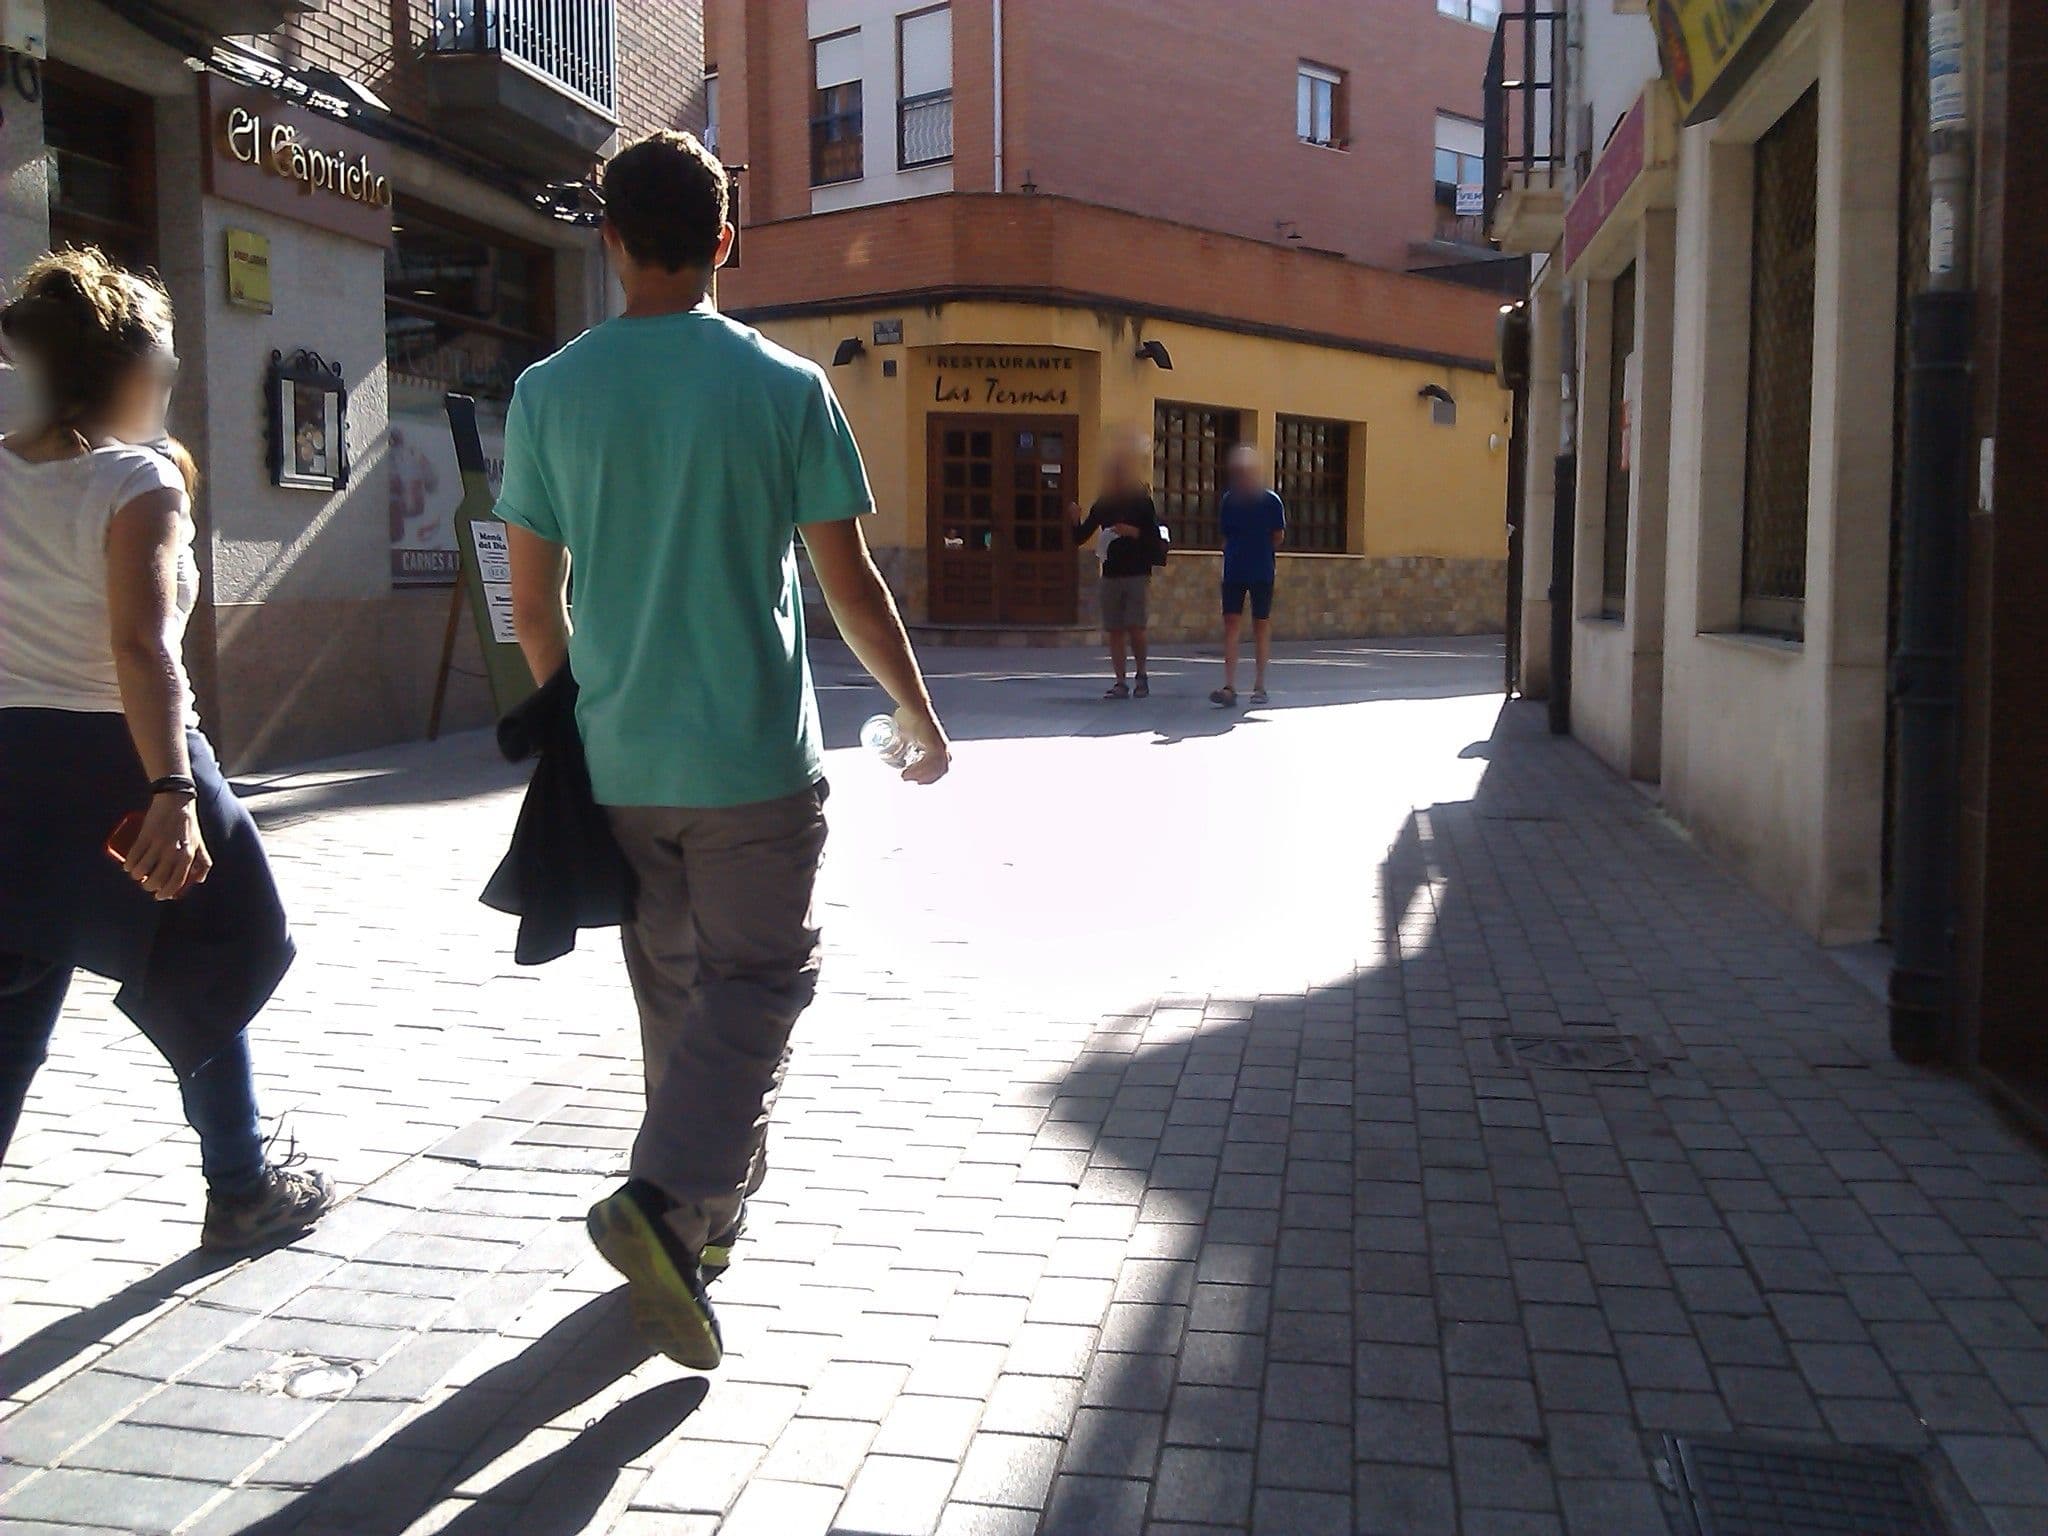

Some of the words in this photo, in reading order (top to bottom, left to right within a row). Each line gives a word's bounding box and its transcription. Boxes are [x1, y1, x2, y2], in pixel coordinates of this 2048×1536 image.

[227, 106, 261, 165] El
[270, 123, 393, 208] Capricho
[937, 355, 1072, 369] RESTAURANTE
[935, 374, 970, 402] Las
[984, 377, 1067, 404] Termas
[479, 541, 492, 550] del
[402, 551, 446, 571] CARNES
